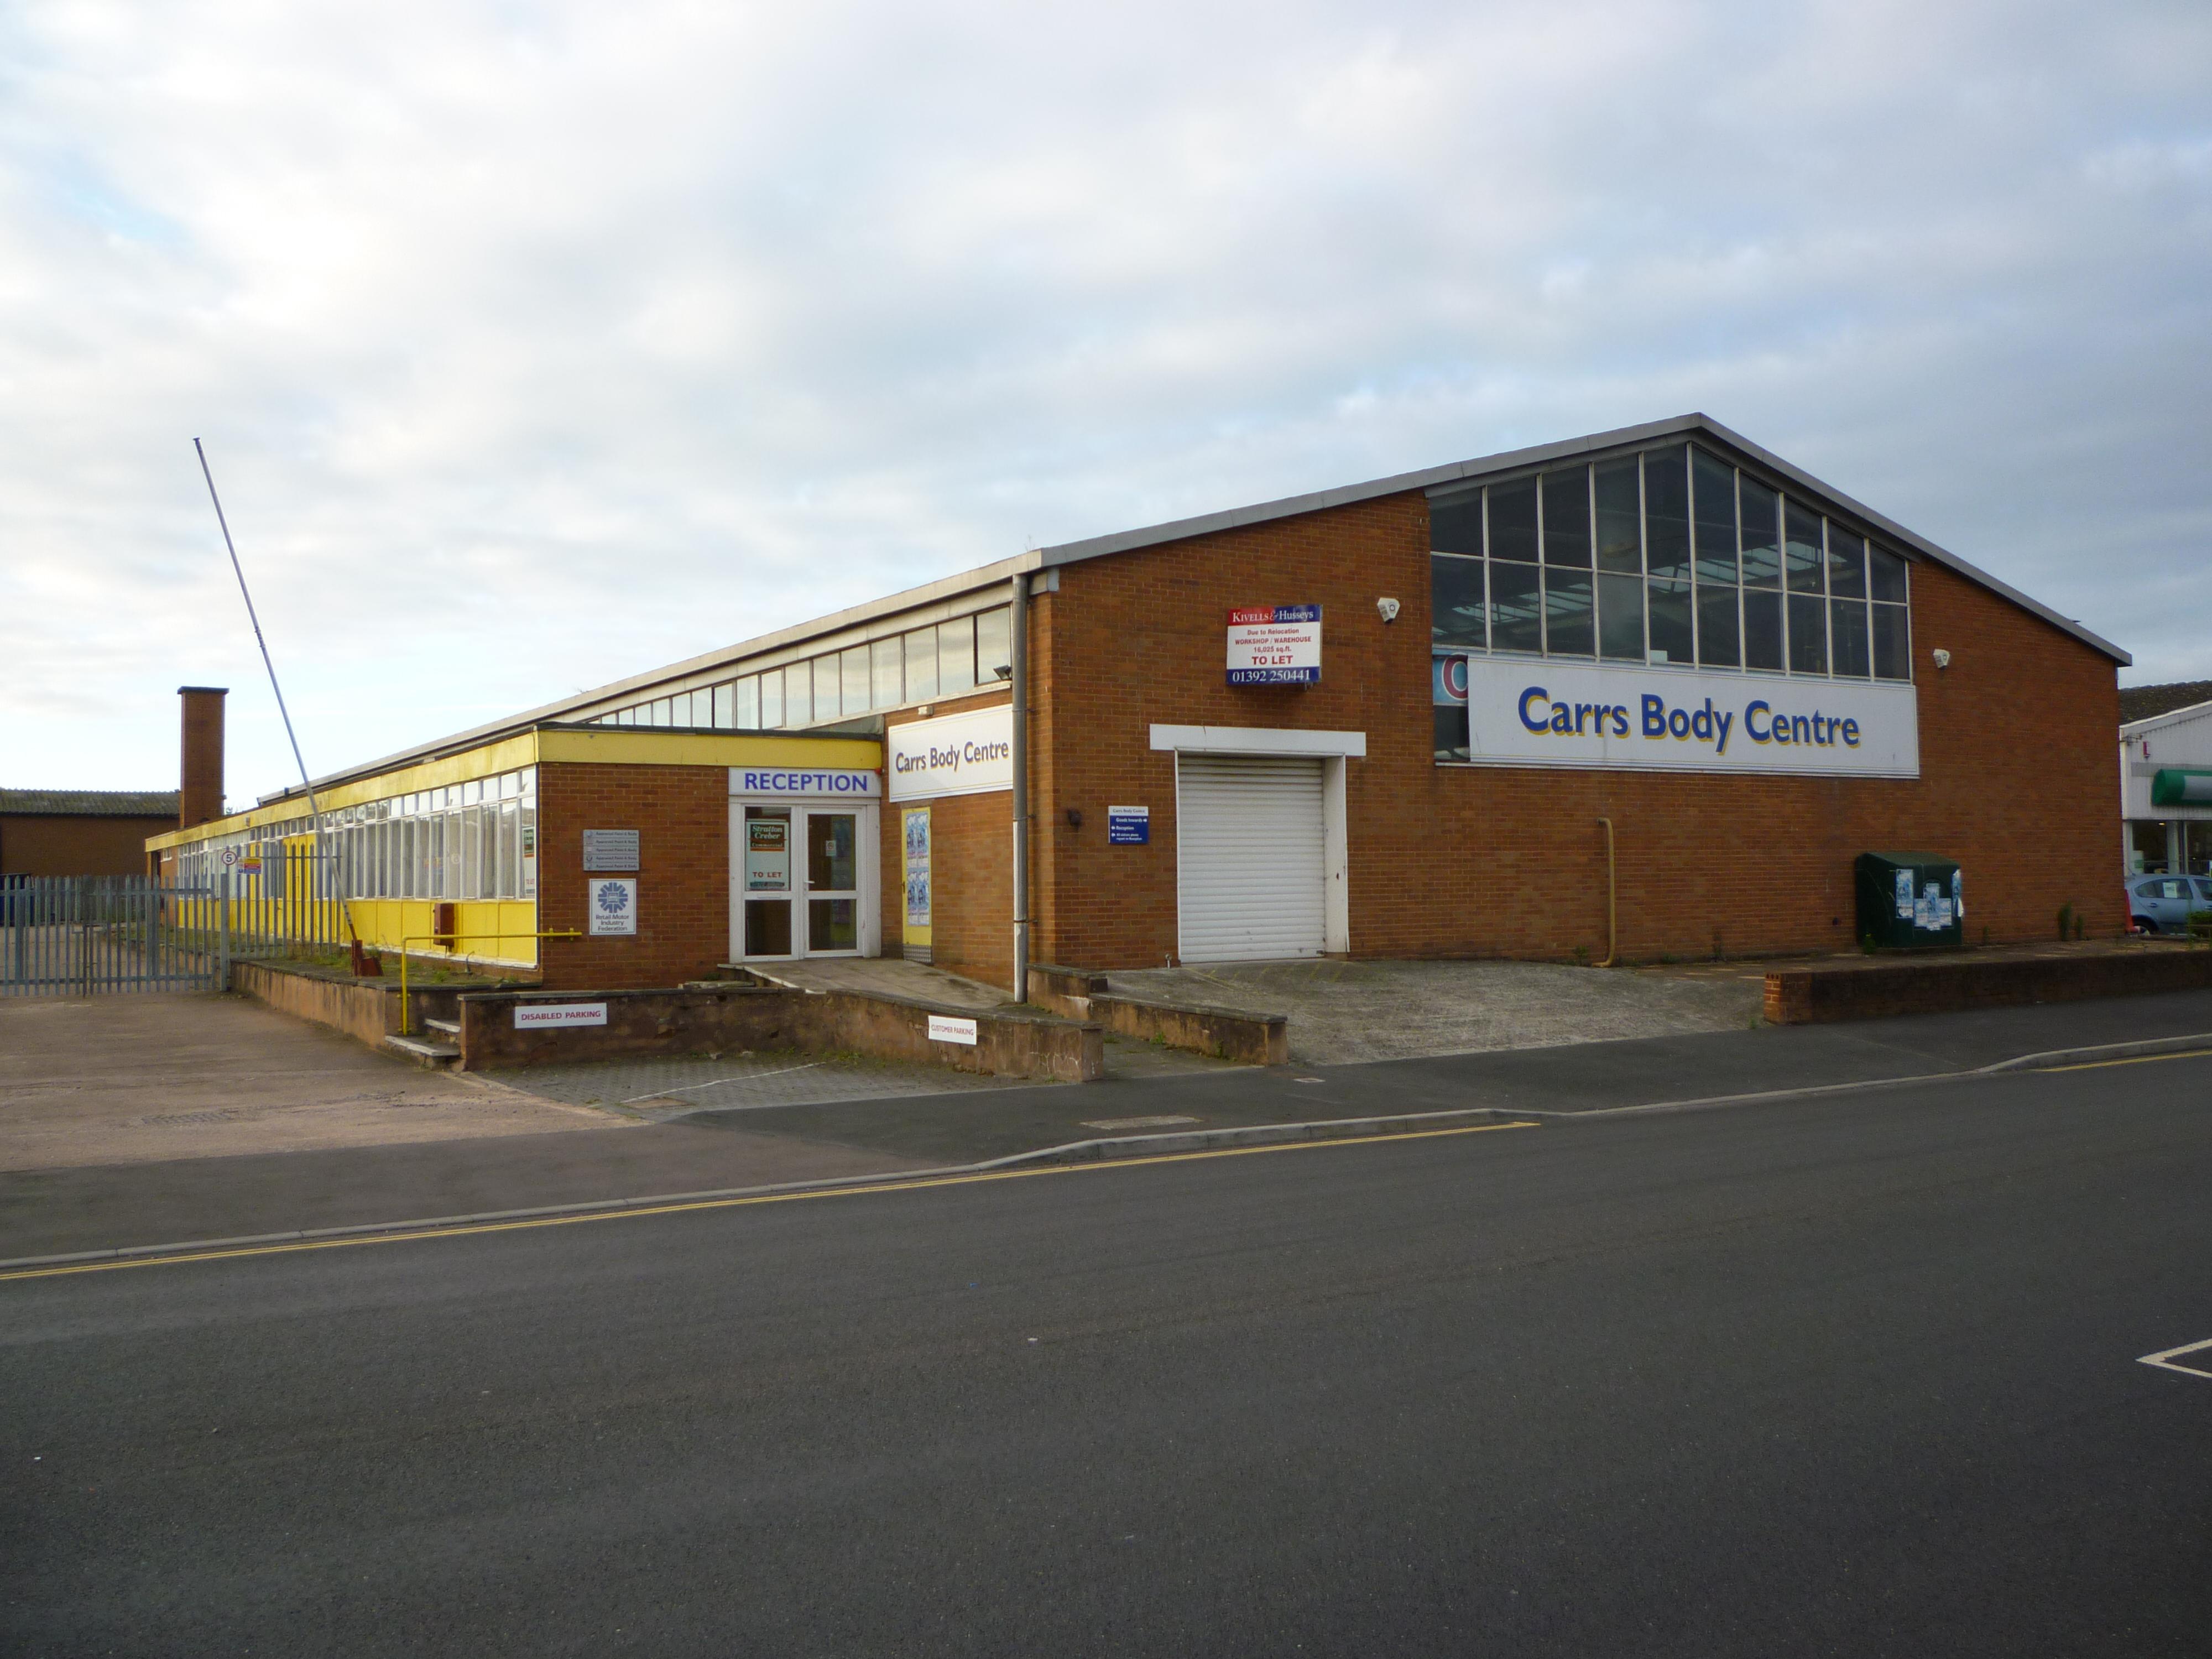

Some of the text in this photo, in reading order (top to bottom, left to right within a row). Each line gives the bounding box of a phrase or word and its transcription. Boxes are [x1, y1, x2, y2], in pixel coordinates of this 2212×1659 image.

[1233, 612, 1269, 622] KIVELLS
[1279, 609, 1313, 622] Husseys
[1251, 655, 1293, 665] TO LET
[1233, 669, 1310, 682] 01392 250441
[1518, 686, 1861, 755] Carrs Body Centre
[896, 740, 1009, 773] Carrs Body Centre
[745, 773, 867, 791] RECEPTION
[226, 854, 232, 862] 5
[565, 1010, 601, 1019] PARKING
[954, 1027, 974, 1036] PARKING
